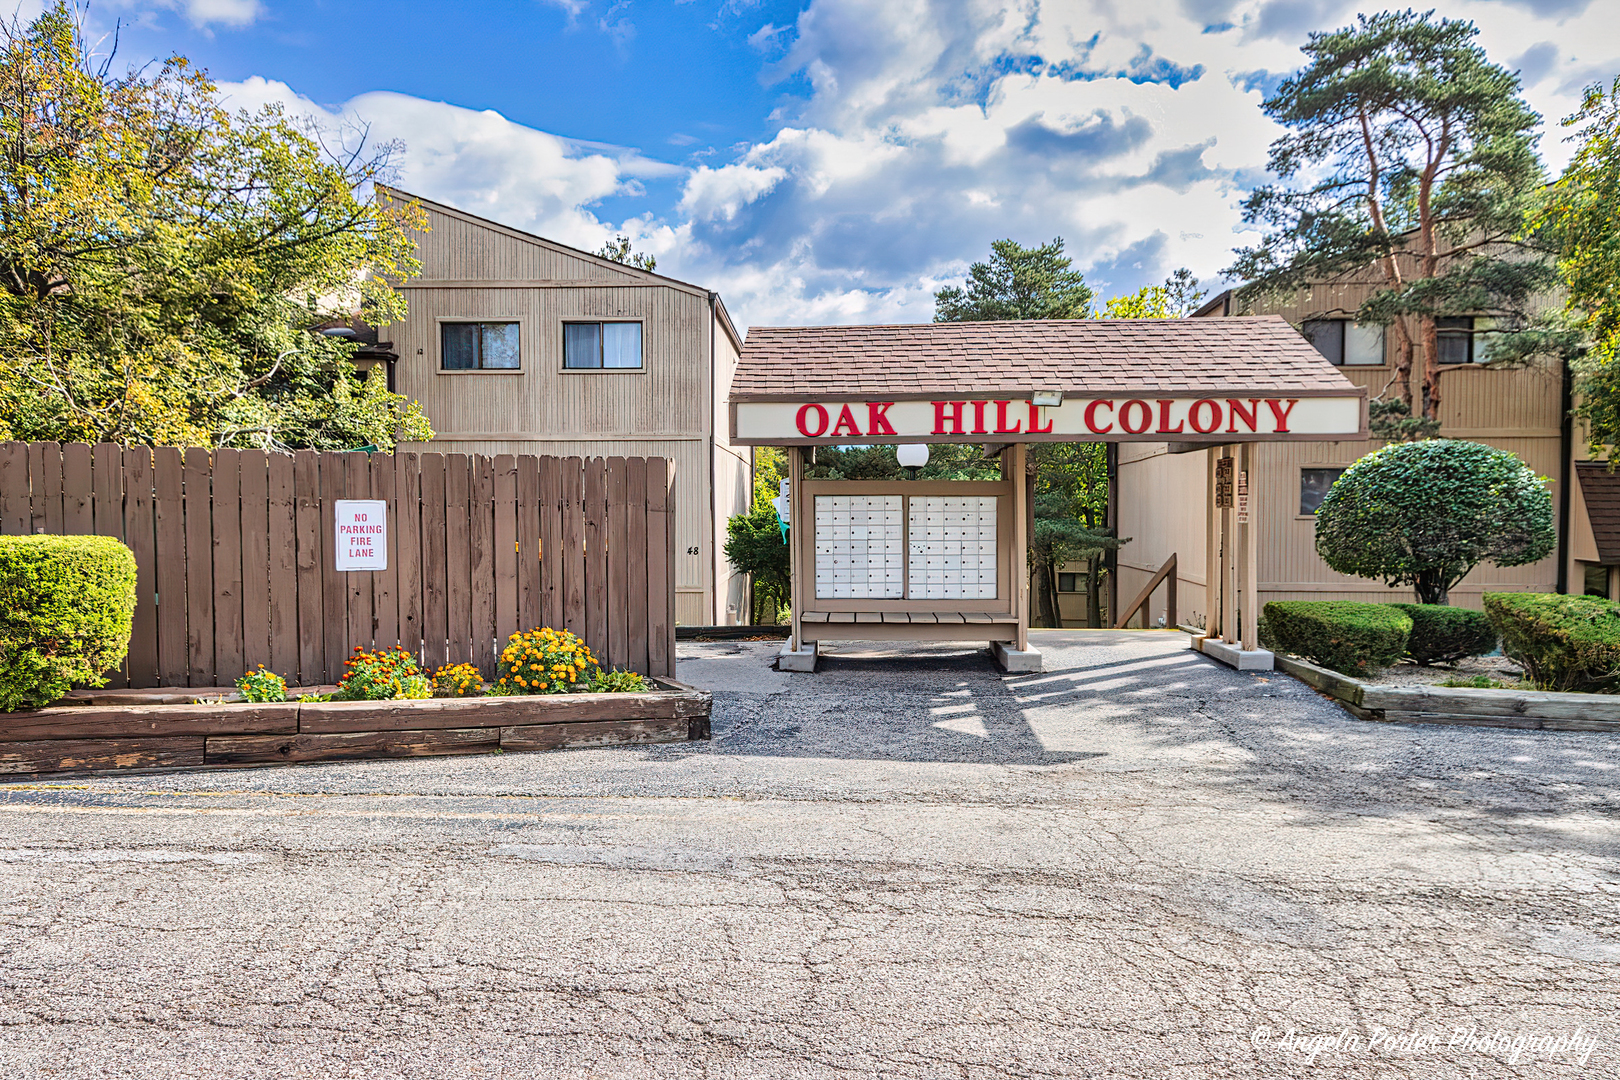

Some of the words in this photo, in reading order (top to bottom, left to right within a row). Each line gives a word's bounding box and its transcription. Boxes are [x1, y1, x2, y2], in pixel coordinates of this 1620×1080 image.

[795, 402, 898, 437] OAK
[930, 400, 1053, 435] HILL
[1084, 399, 1299, 434] COLONY
[354, 513, 368, 522] NO
[340, 525, 382, 534] PARKING
[350, 537, 372, 546] FIRE
[348, 548, 374, 558] LANE
[687, 546, 699, 556] 48
